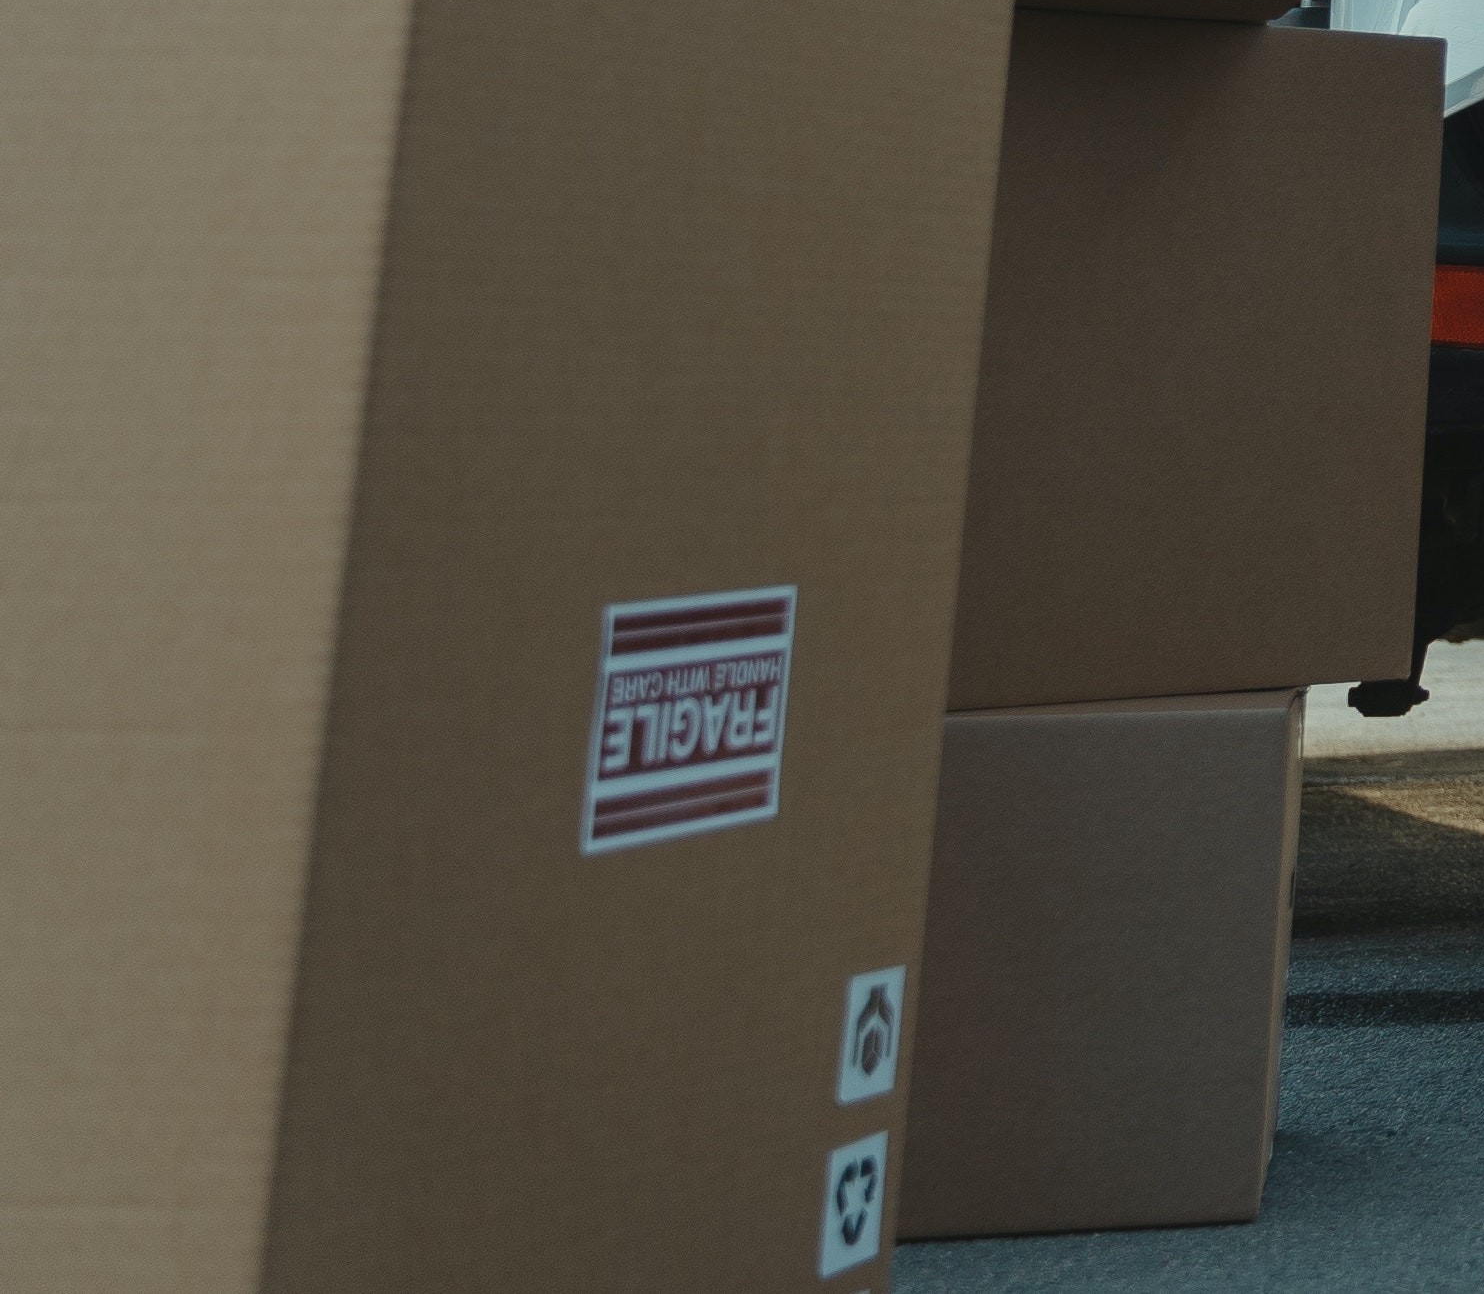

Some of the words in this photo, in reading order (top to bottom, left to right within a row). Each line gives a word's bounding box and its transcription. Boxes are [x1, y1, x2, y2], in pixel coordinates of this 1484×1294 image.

[612, 671, 664, 704] CARE
[666, 666, 712, 697] WITH
[715, 655, 785, 688] HANDLE
[602, 684, 780, 771] FRAGILE
